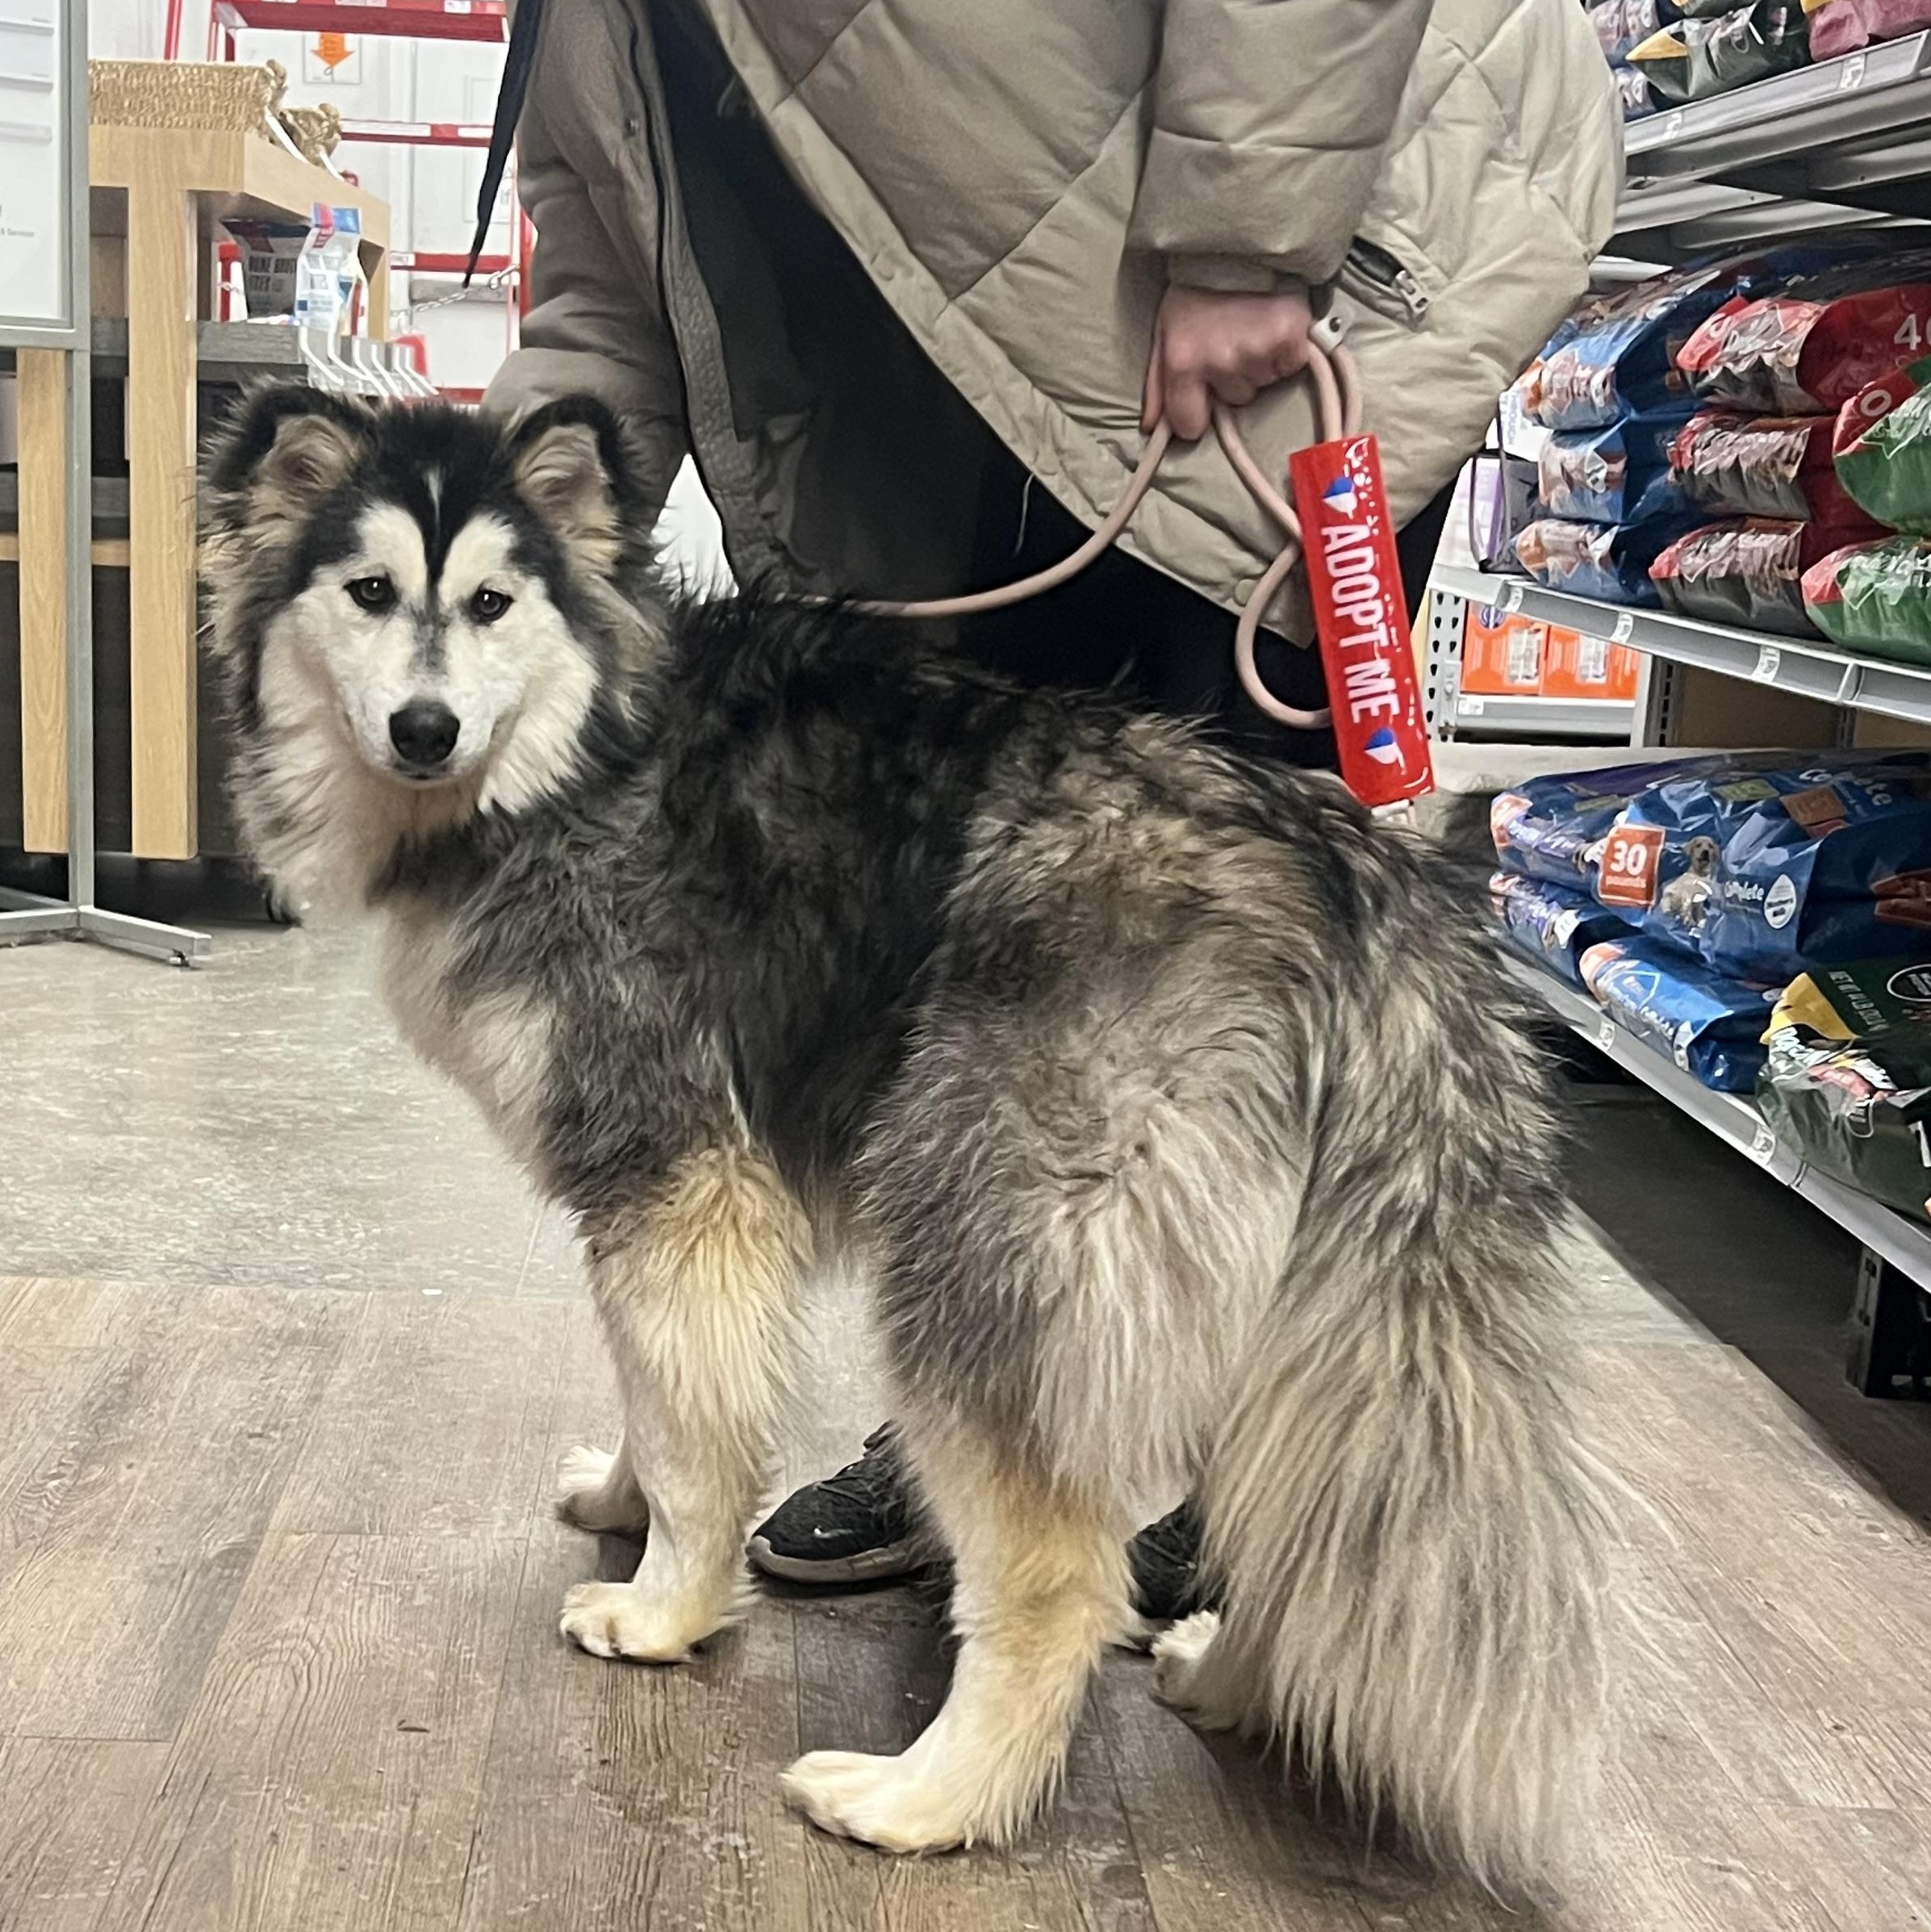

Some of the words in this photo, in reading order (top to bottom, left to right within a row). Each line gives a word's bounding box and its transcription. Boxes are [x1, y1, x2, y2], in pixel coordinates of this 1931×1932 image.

[1893, 313, 1931, 350] 4
[1321, 523, 1389, 647] ADOPT
[1344, 659, 1400, 725] ME
[1609, 840, 1648, 876] 30
